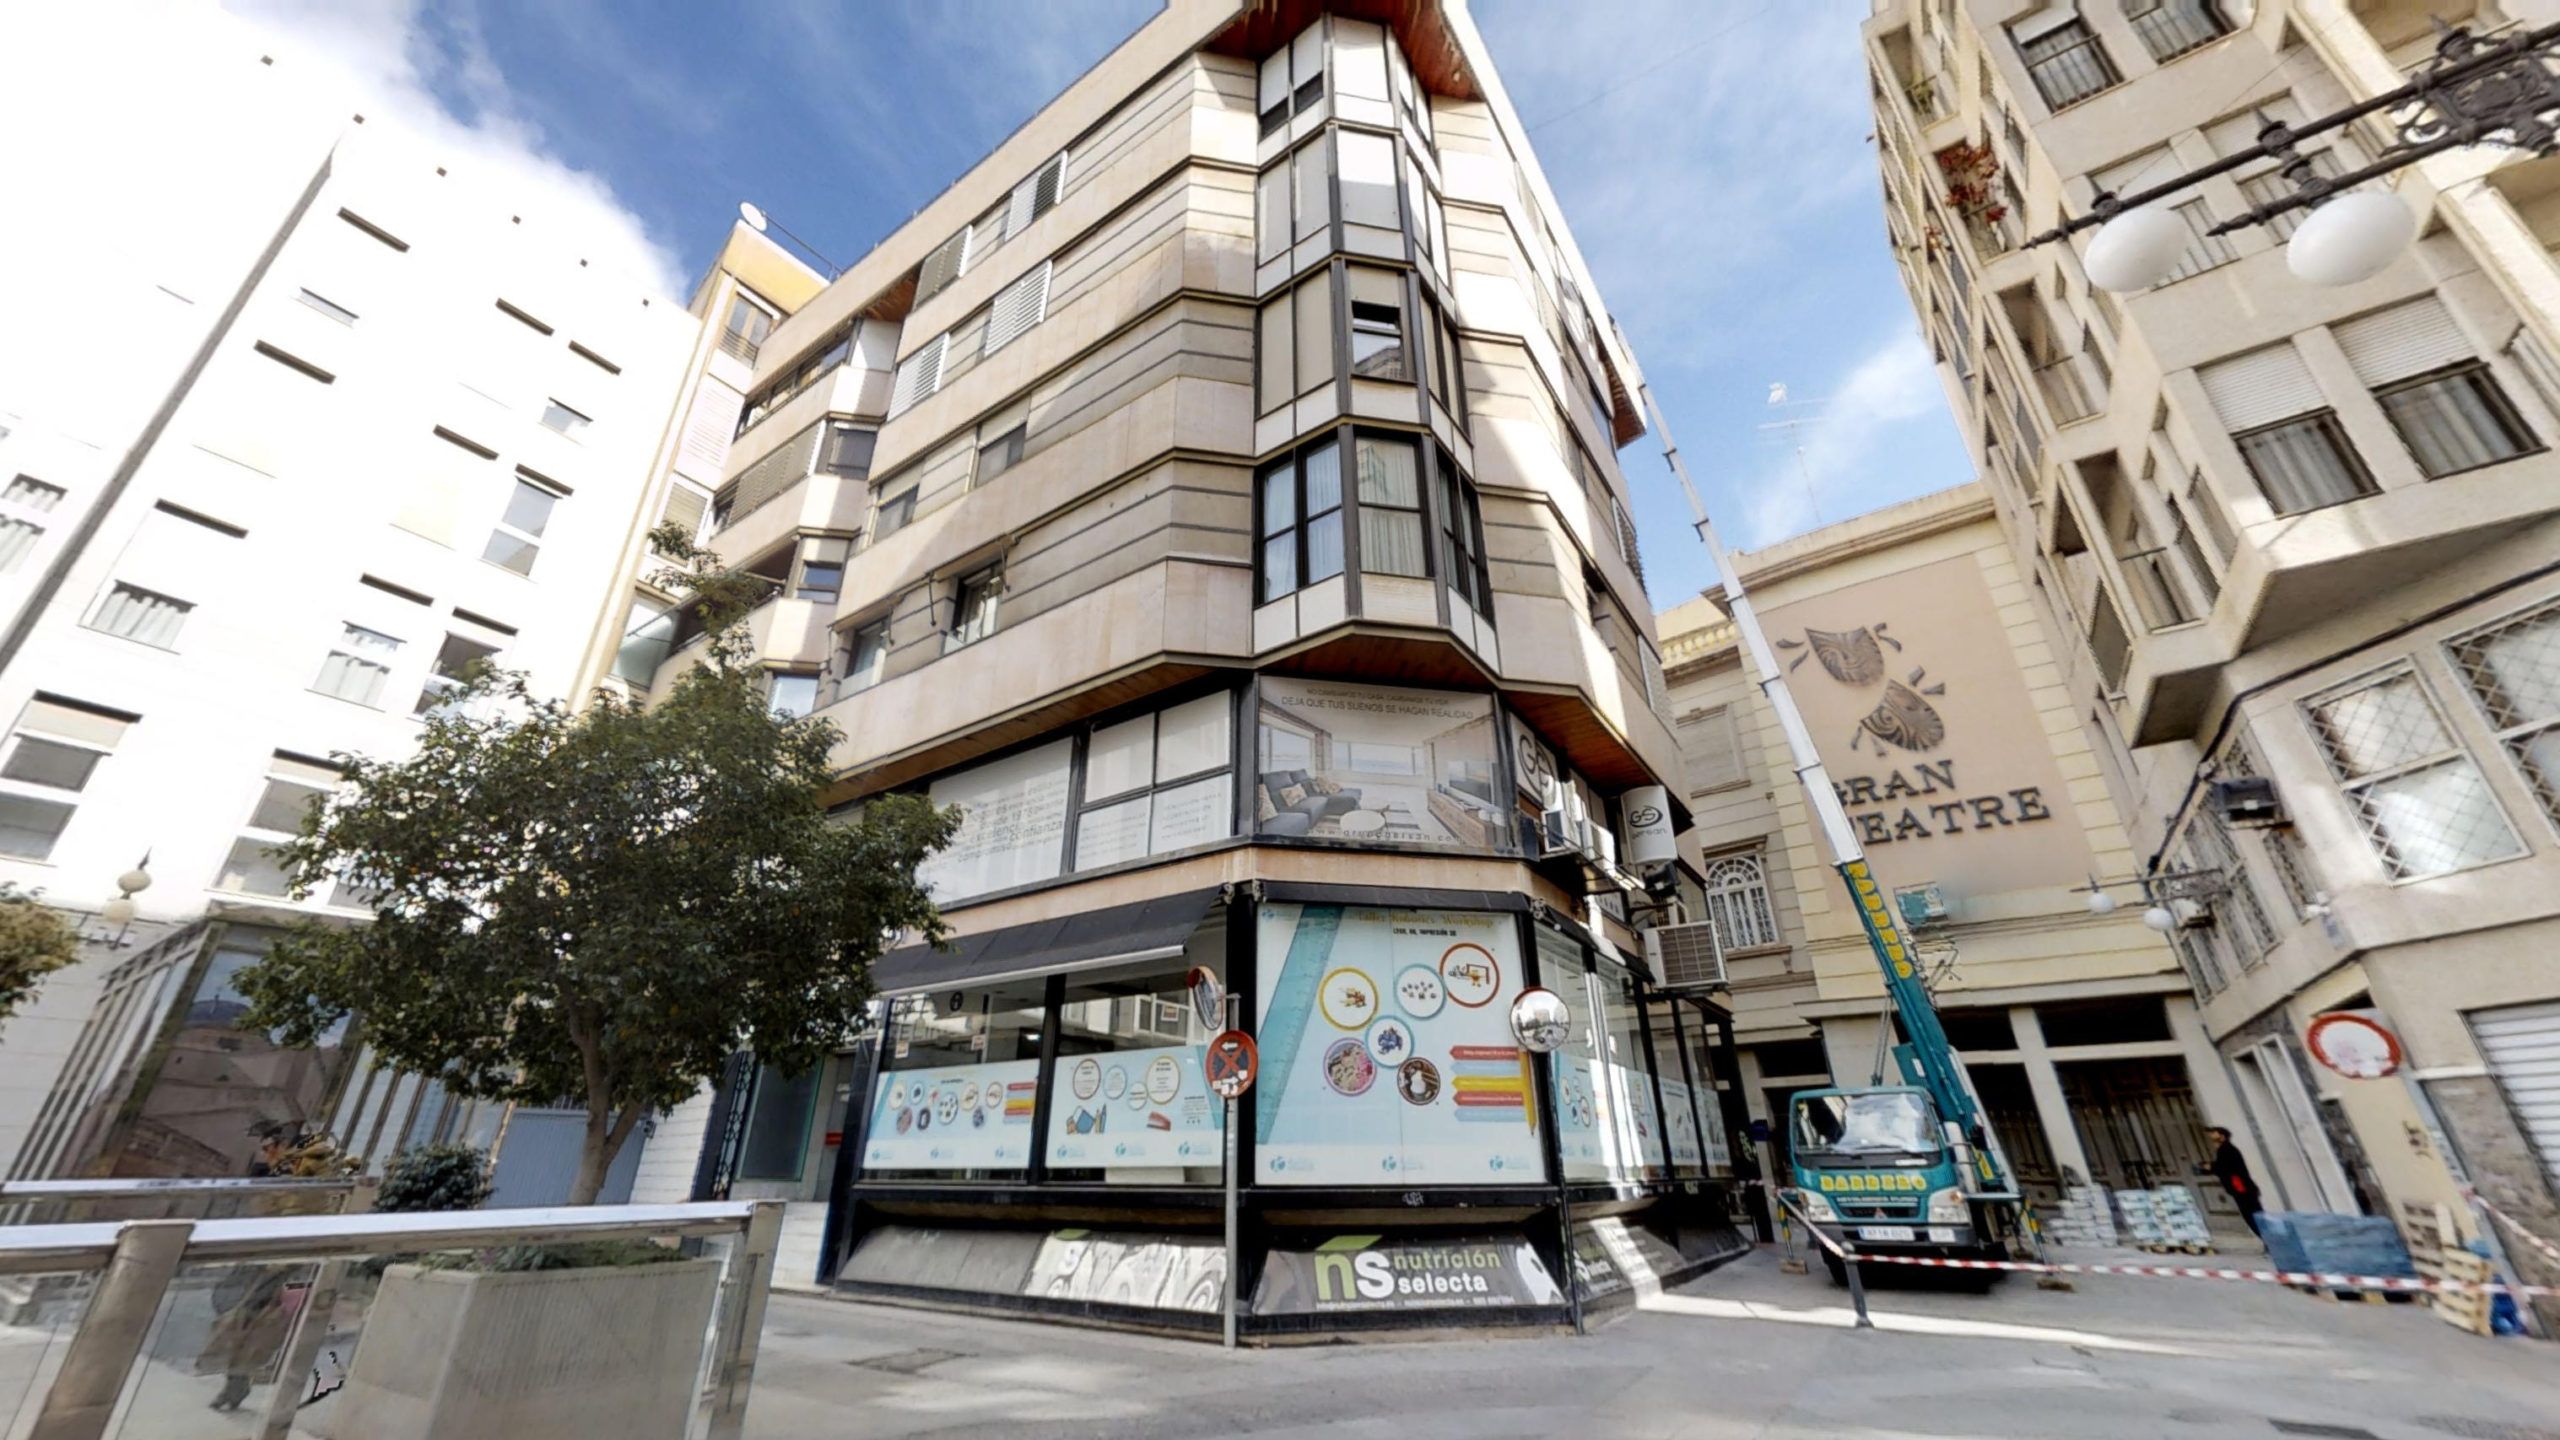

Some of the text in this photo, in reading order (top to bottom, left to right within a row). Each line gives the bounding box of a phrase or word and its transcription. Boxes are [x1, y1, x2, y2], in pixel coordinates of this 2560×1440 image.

[1281, 696, 1304, 706] DEJA
[1306, 697, 1325, 709] QUE
[1328, 699, 1344, 710] TUS
[1849, 786, 2052, 846] EATRE
[1394, 1249, 1501, 1270] nutrición
[1398, 1272, 1488, 1294] selecta
